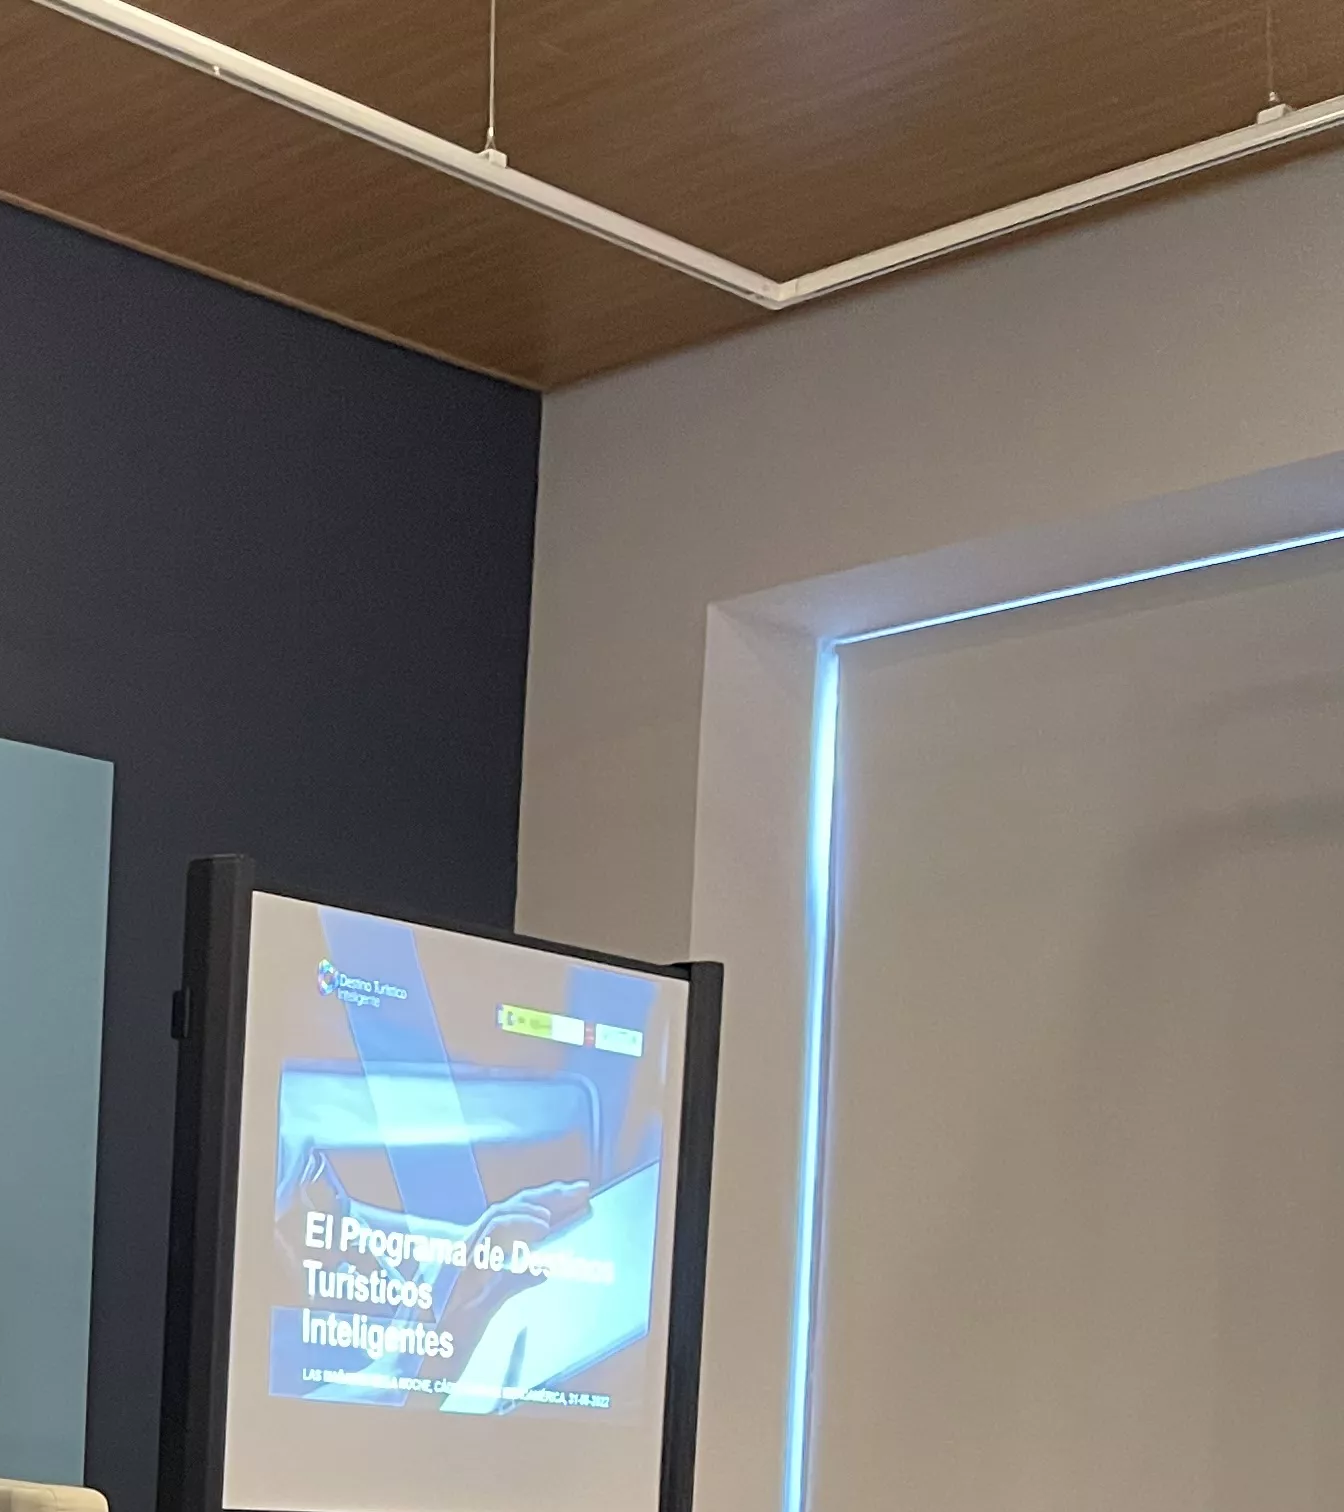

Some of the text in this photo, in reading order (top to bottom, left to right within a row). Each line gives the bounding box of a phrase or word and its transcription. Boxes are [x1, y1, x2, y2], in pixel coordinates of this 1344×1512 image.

[304, 1211, 333, 1250] El
[339, 1217, 467, 1267] Programa
[473, 1236, 504, 1272] de
[302, 1259, 433, 1310] Turísticos
[302, 1308, 454, 1360] Inteligentes
